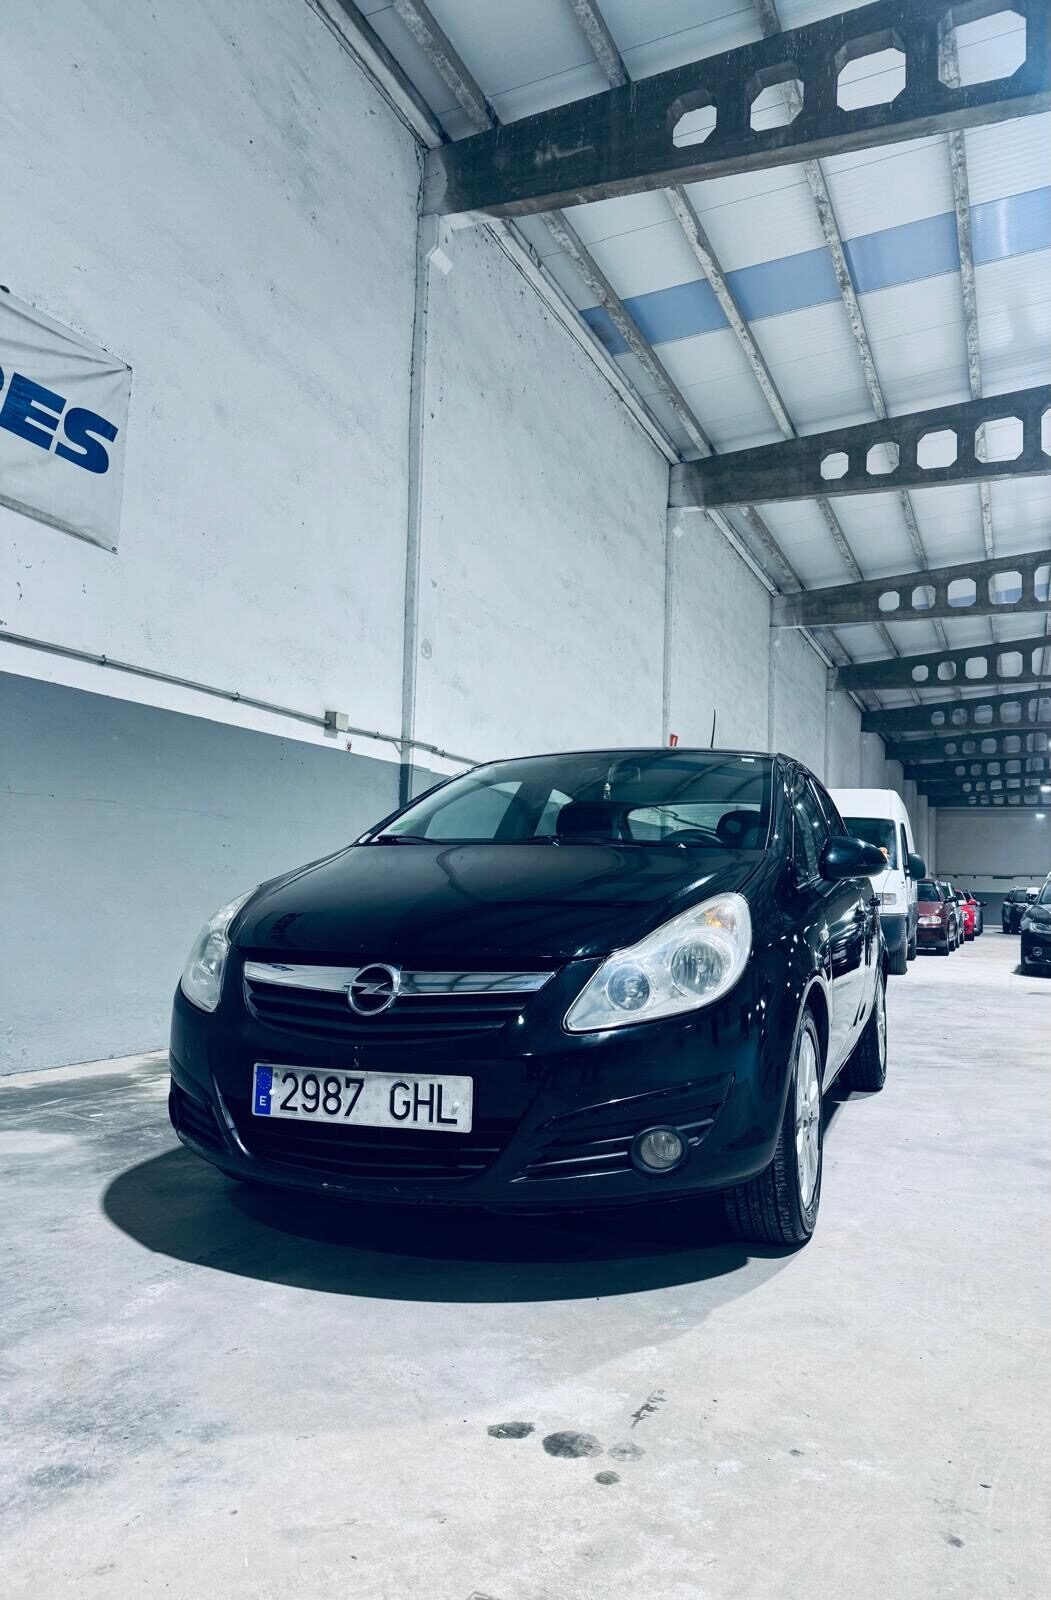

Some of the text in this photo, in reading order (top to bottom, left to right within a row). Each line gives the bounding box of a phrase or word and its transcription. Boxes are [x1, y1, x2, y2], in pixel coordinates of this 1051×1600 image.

[0, 365, 119, 475] ES
[259, 1095, 267, 1107] E
[279, 1072, 458, 1125] 2987 GHL
